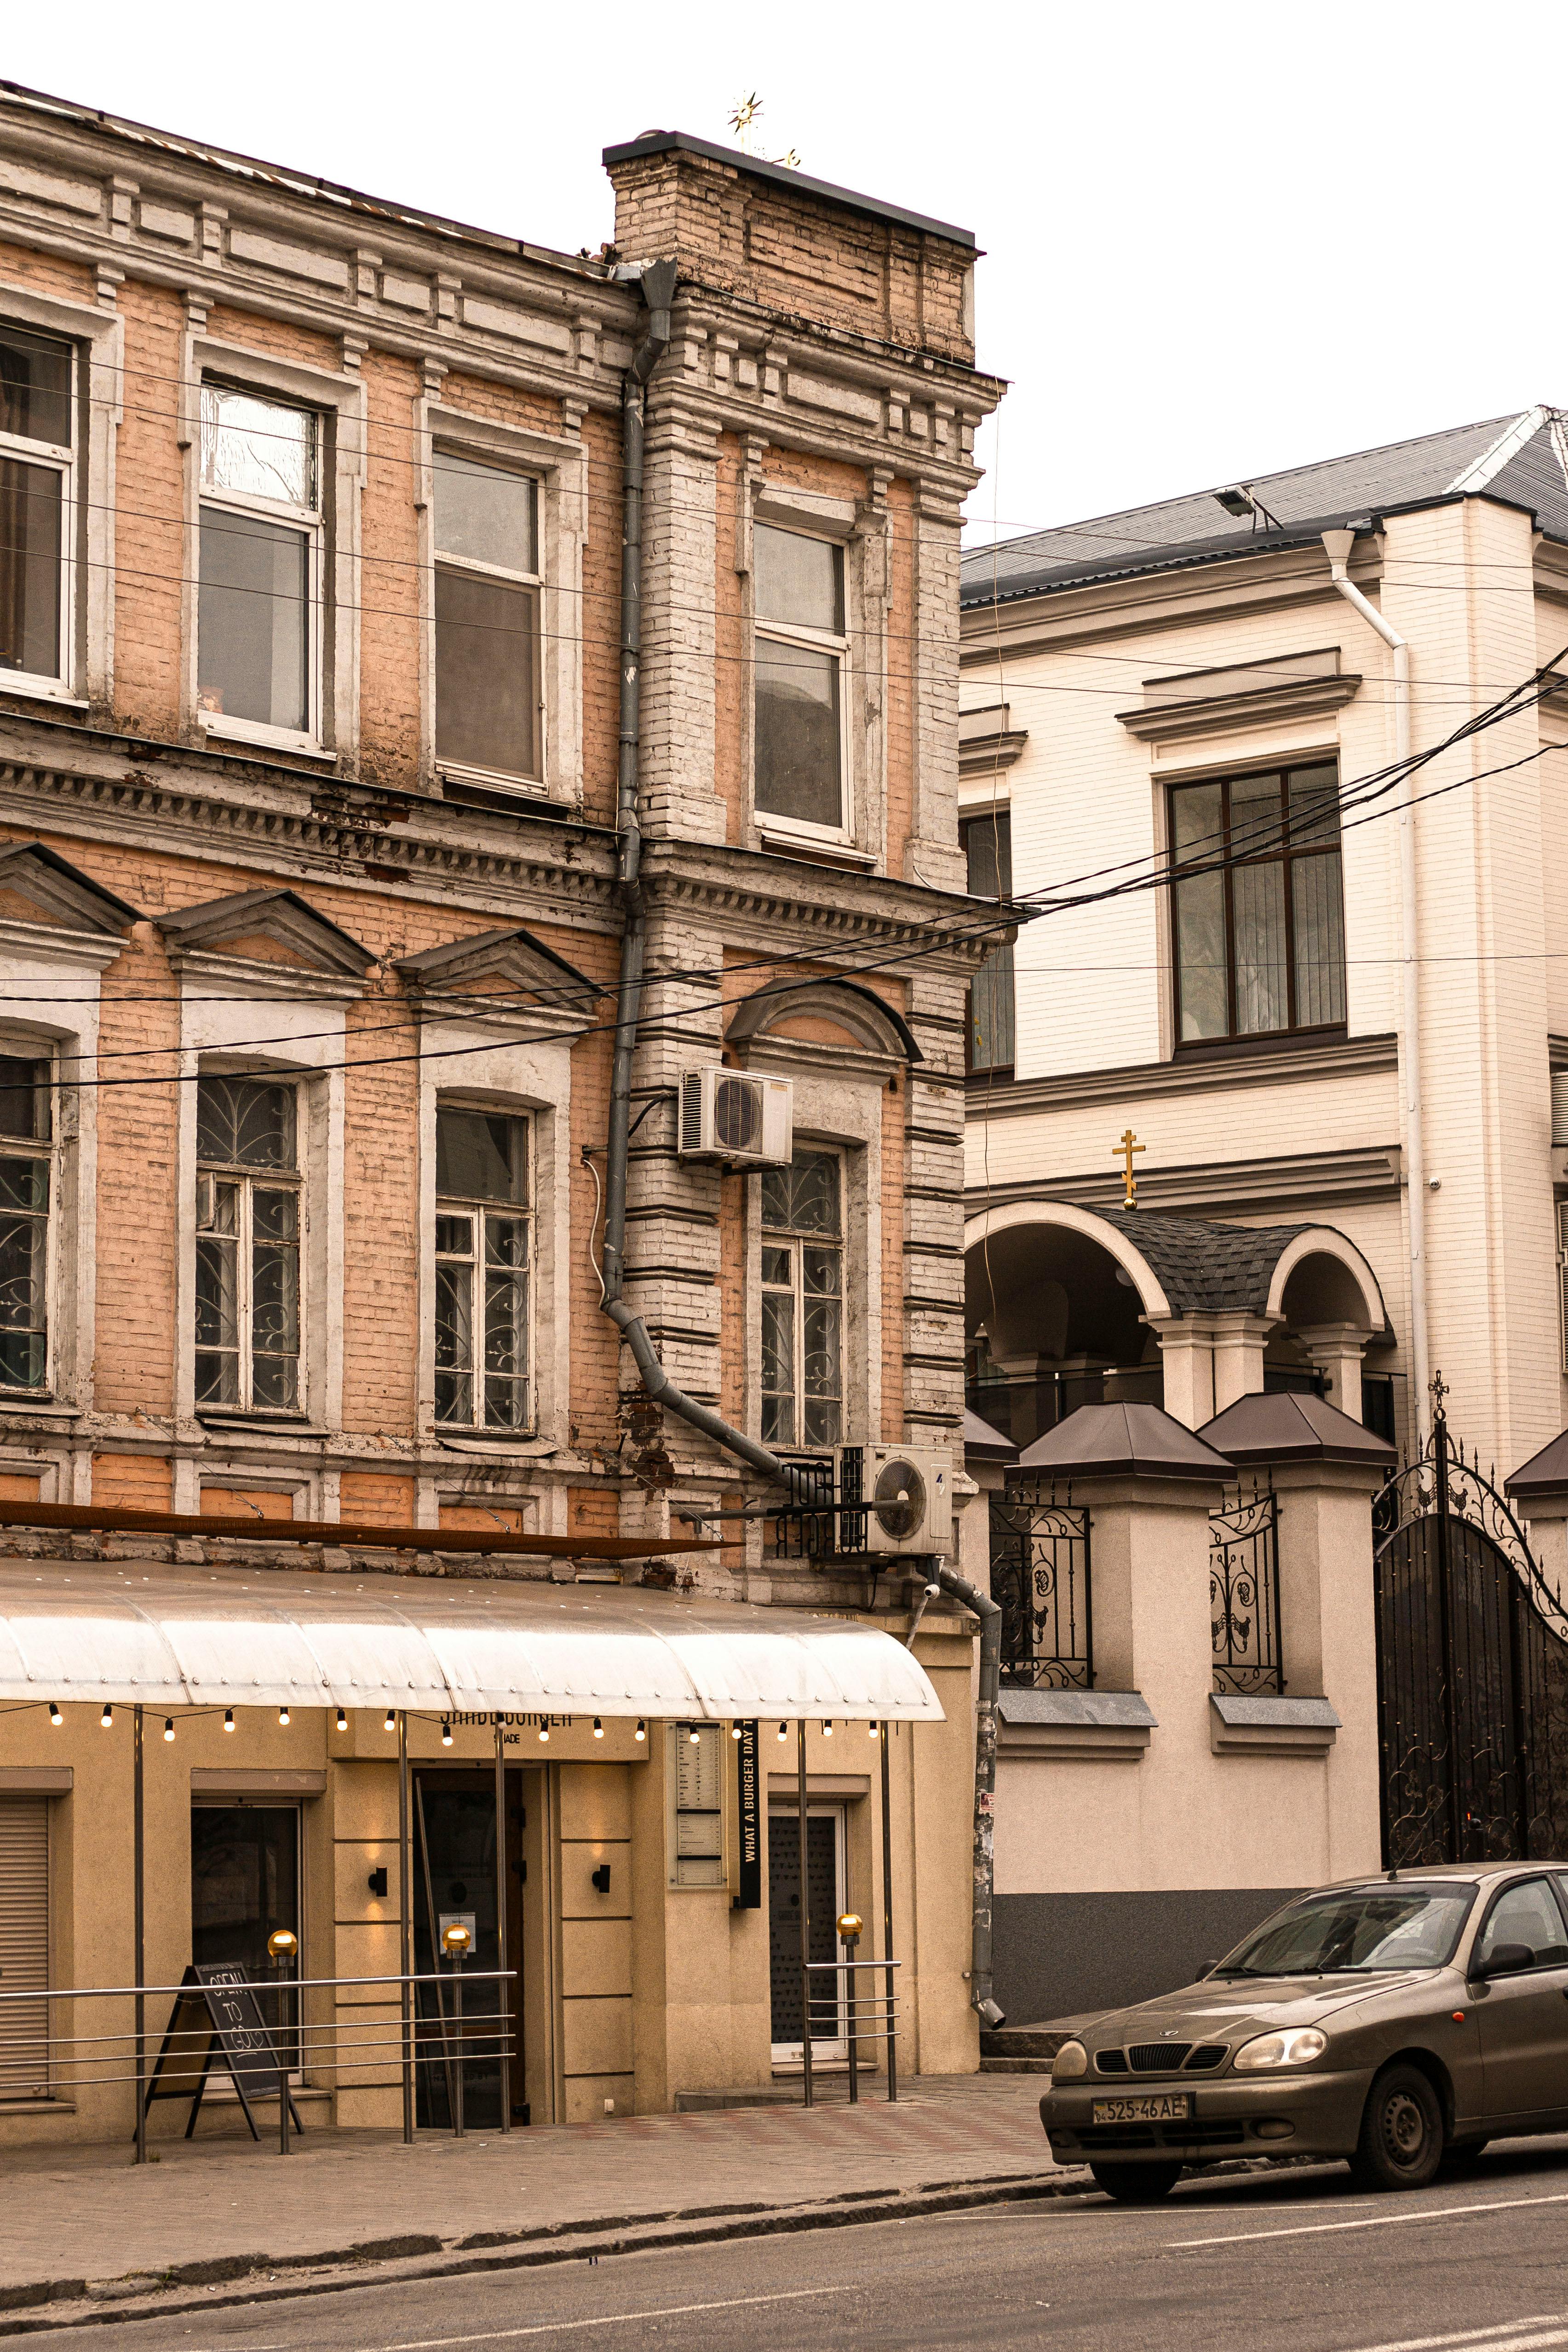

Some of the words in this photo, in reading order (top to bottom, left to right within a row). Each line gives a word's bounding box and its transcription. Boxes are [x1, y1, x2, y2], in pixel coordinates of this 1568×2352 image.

[743, 1730, 753, 1754] DAY
[744, 1759, 754, 1810] BURGER
[744, 1814, 754, 1822] A
[745, 1826, 755, 1863] WHAT
[222, 2002, 242, 2022] TO
[230, 2025, 251, 2050] GO
